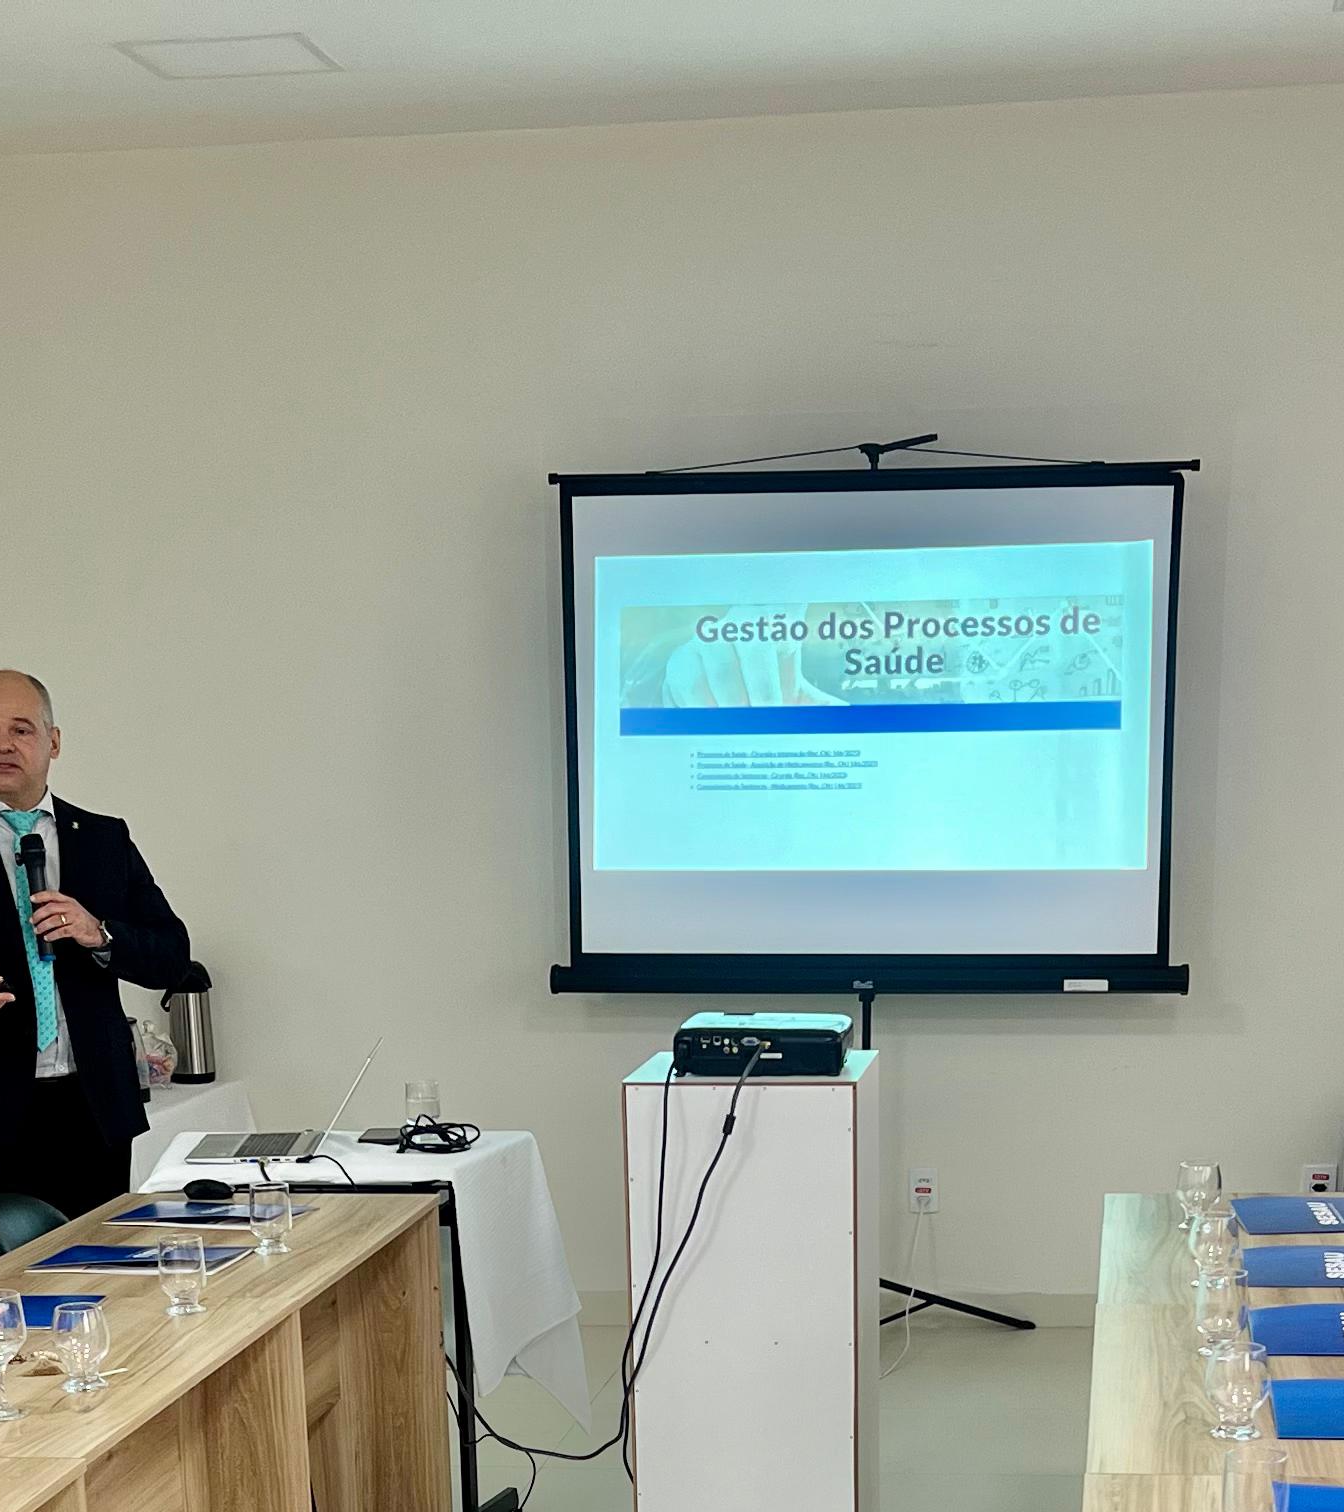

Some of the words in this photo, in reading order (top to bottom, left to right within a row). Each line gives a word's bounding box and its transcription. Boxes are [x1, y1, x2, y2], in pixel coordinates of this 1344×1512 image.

[695, 613, 809, 643] Gestão
[818, 611, 874, 641] dos
[883, 608, 1051, 640] Processos
[1059, 605, 1102, 636] de
[843, 642, 945, 676] Saúde
[1306, 1201, 1340, 1226] SESAU
